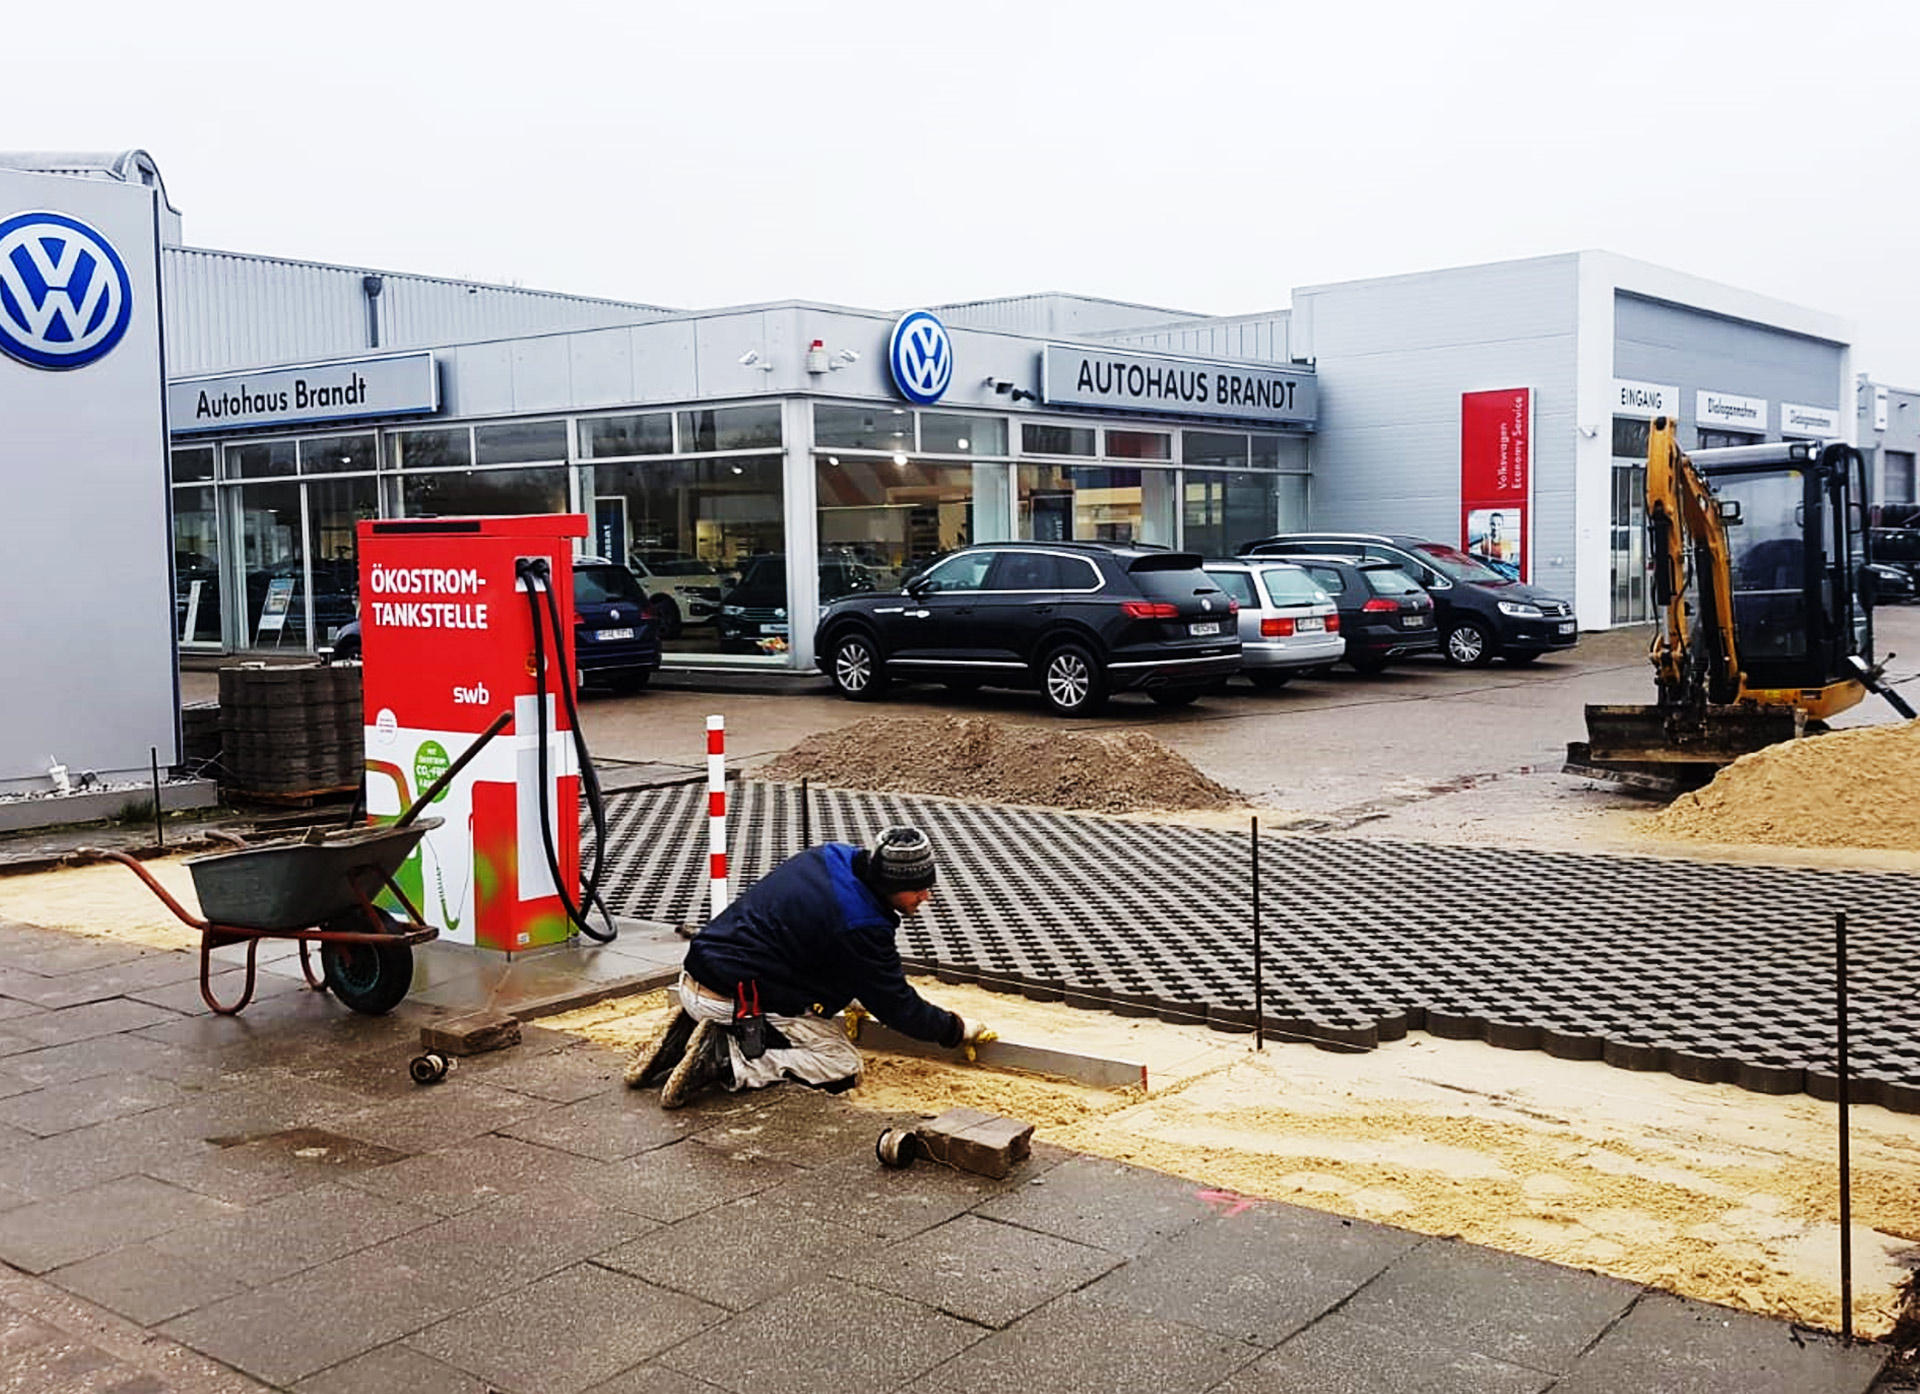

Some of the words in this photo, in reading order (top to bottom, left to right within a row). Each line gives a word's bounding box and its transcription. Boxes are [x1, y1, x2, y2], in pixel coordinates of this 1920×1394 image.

[196, 384, 288, 419] Autohaus
[295, 372, 367, 409] Brandt
[1077, 359, 1208, 402] AUTOHAUS
[1216, 374, 1297, 410] BRANDT
[1621, 387, 1662, 410] EINGANG
[1511, 396, 1523, 436] Service
[1496, 422, 1509, 490] Volkswagen
[1511, 440, 1524, 489] Economy
[371, 563, 487, 594] ÖKOSTROM-
[371, 602, 488, 629] TANKSTELLE
[453, 681, 490, 705] swb
